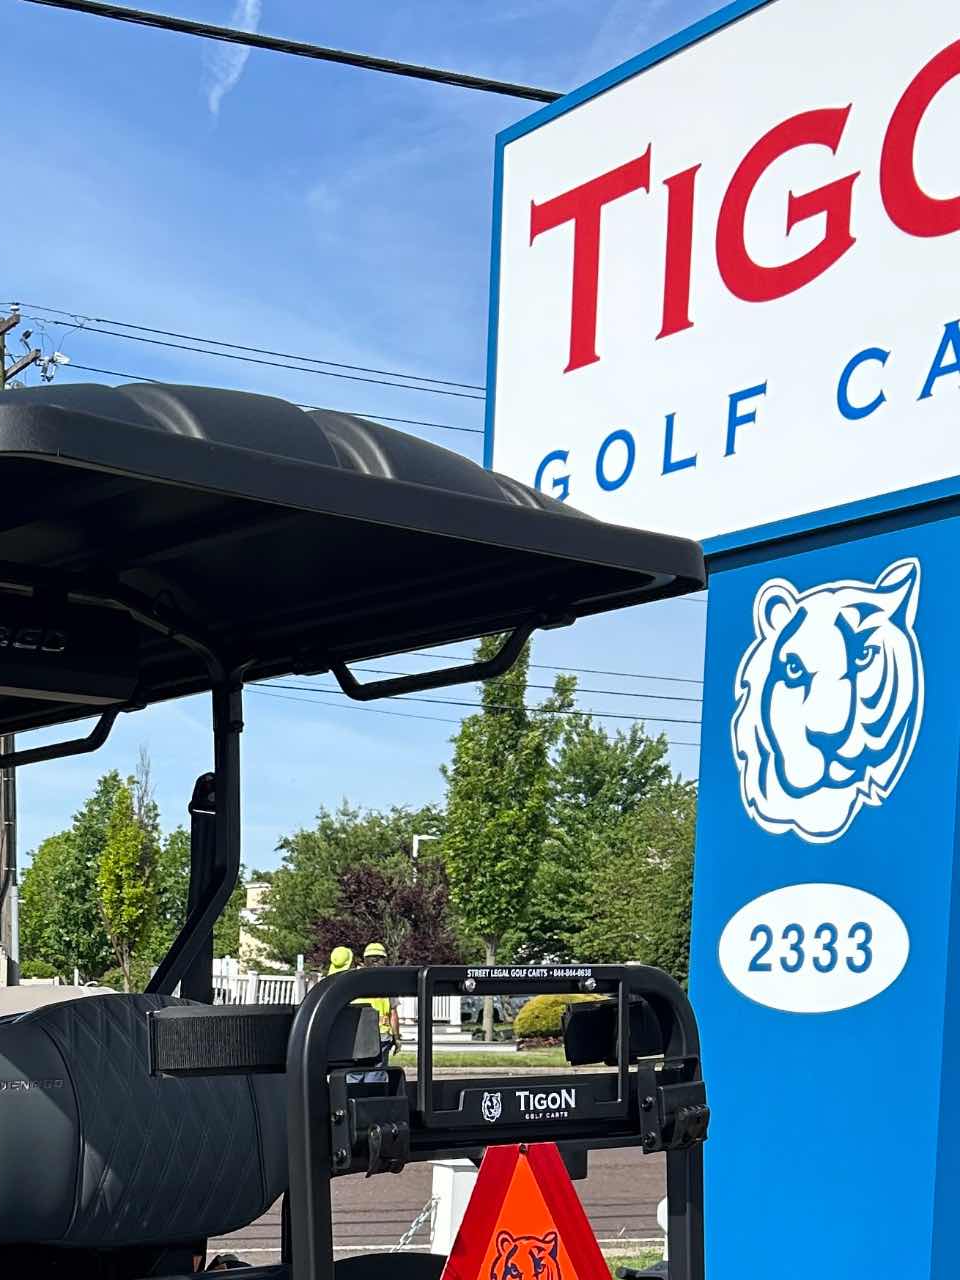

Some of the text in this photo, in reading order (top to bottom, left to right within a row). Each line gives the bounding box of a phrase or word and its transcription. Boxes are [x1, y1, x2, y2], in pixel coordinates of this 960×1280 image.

[534, 318, 960, 503] GOLF CA
[747, 921, 873, 974] 2333
[467, 968, 490, 978] STREET
[490, 968, 510, 978] LEGAL
[510, 968, 527, 977] GOLF
[527, 968, 548, 977] CARTS
[515, 1088, 576, 1111] TIGON
[525, 1111, 569, 1120] GOLF CARTS
